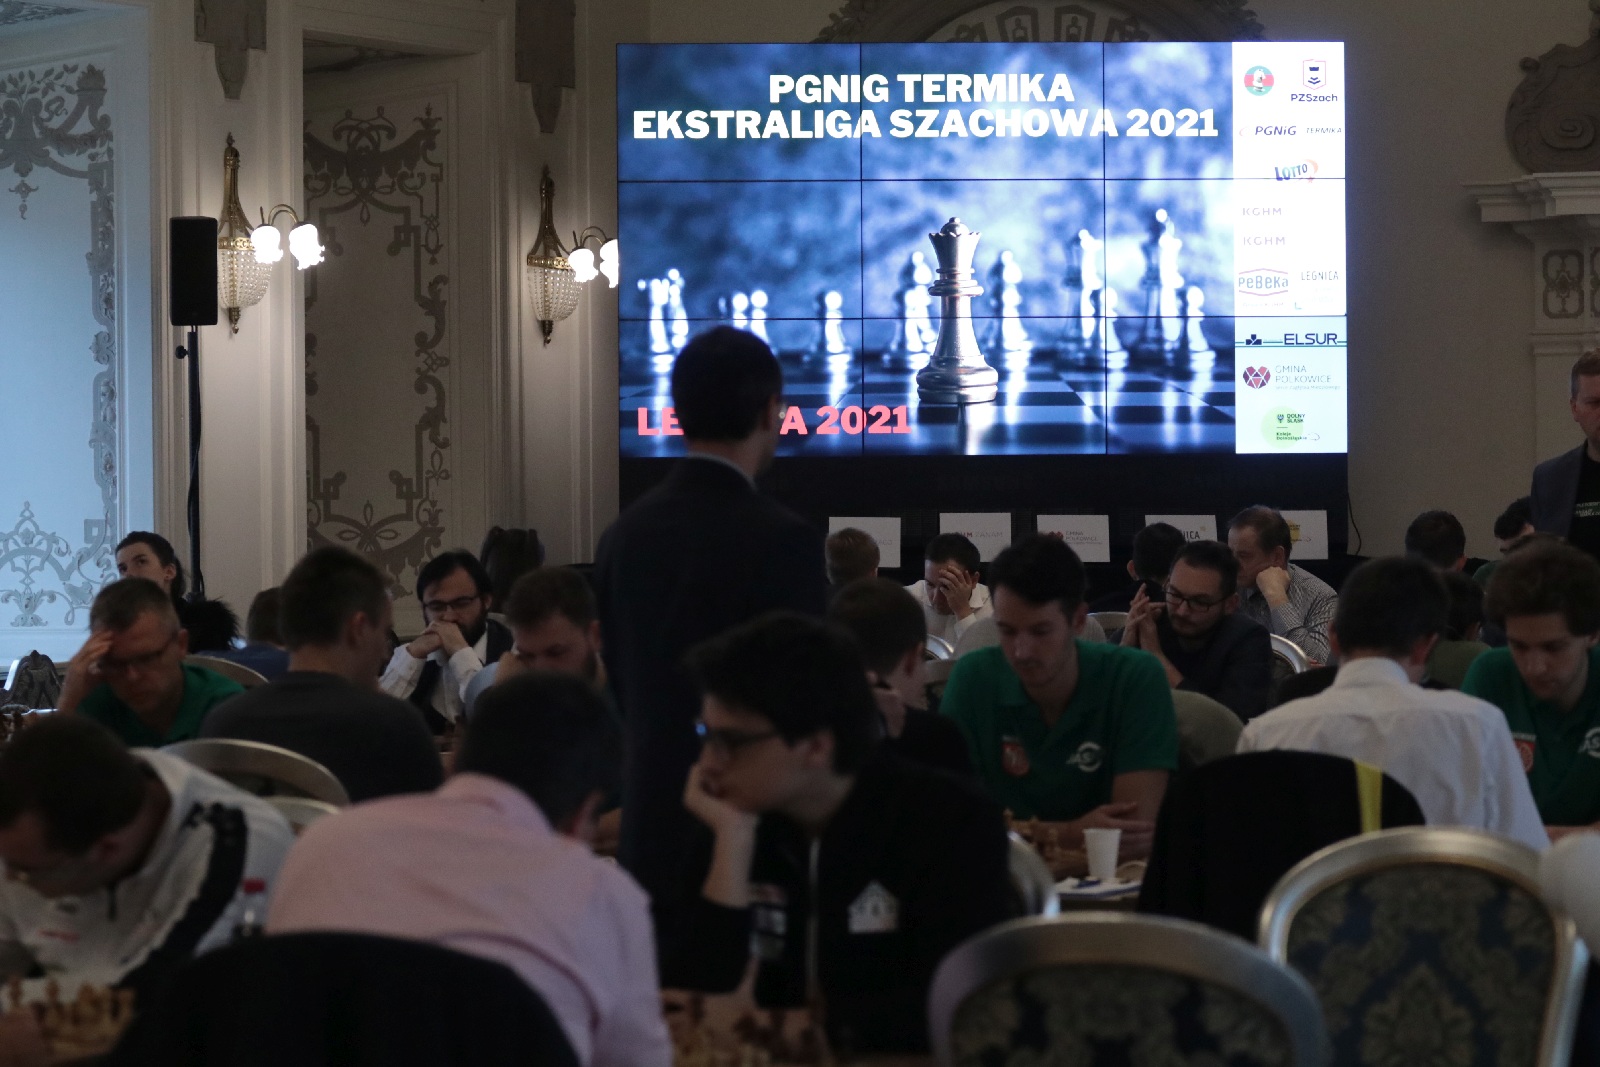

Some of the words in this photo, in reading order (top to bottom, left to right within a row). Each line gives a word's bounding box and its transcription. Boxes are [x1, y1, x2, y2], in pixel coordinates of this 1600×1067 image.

[769, 73, 889, 103] PGNIG
[897, 73, 1075, 103] TERMIKA
[1290, 93, 1338, 102] PZSzach
[633, 109, 882, 139] EKSTRALIGA
[889, 108, 1119, 138] SZACHOWA
[1126, 108, 1219, 137] 2021
[1274, 163, 1308, 181] LOTTO
[1242, 207, 1282, 216] KGHM
[1243, 236, 1286, 246] KGHM
[1301, 270, 1339, 281] LEGNICA
[1284, 333, 1338, 345] ELSUR
[1275, 365, 1307, 373] GMINA
[1275, 375, 1332, 383] POLKOWICE
[816, 405, 912, 435] 2021
